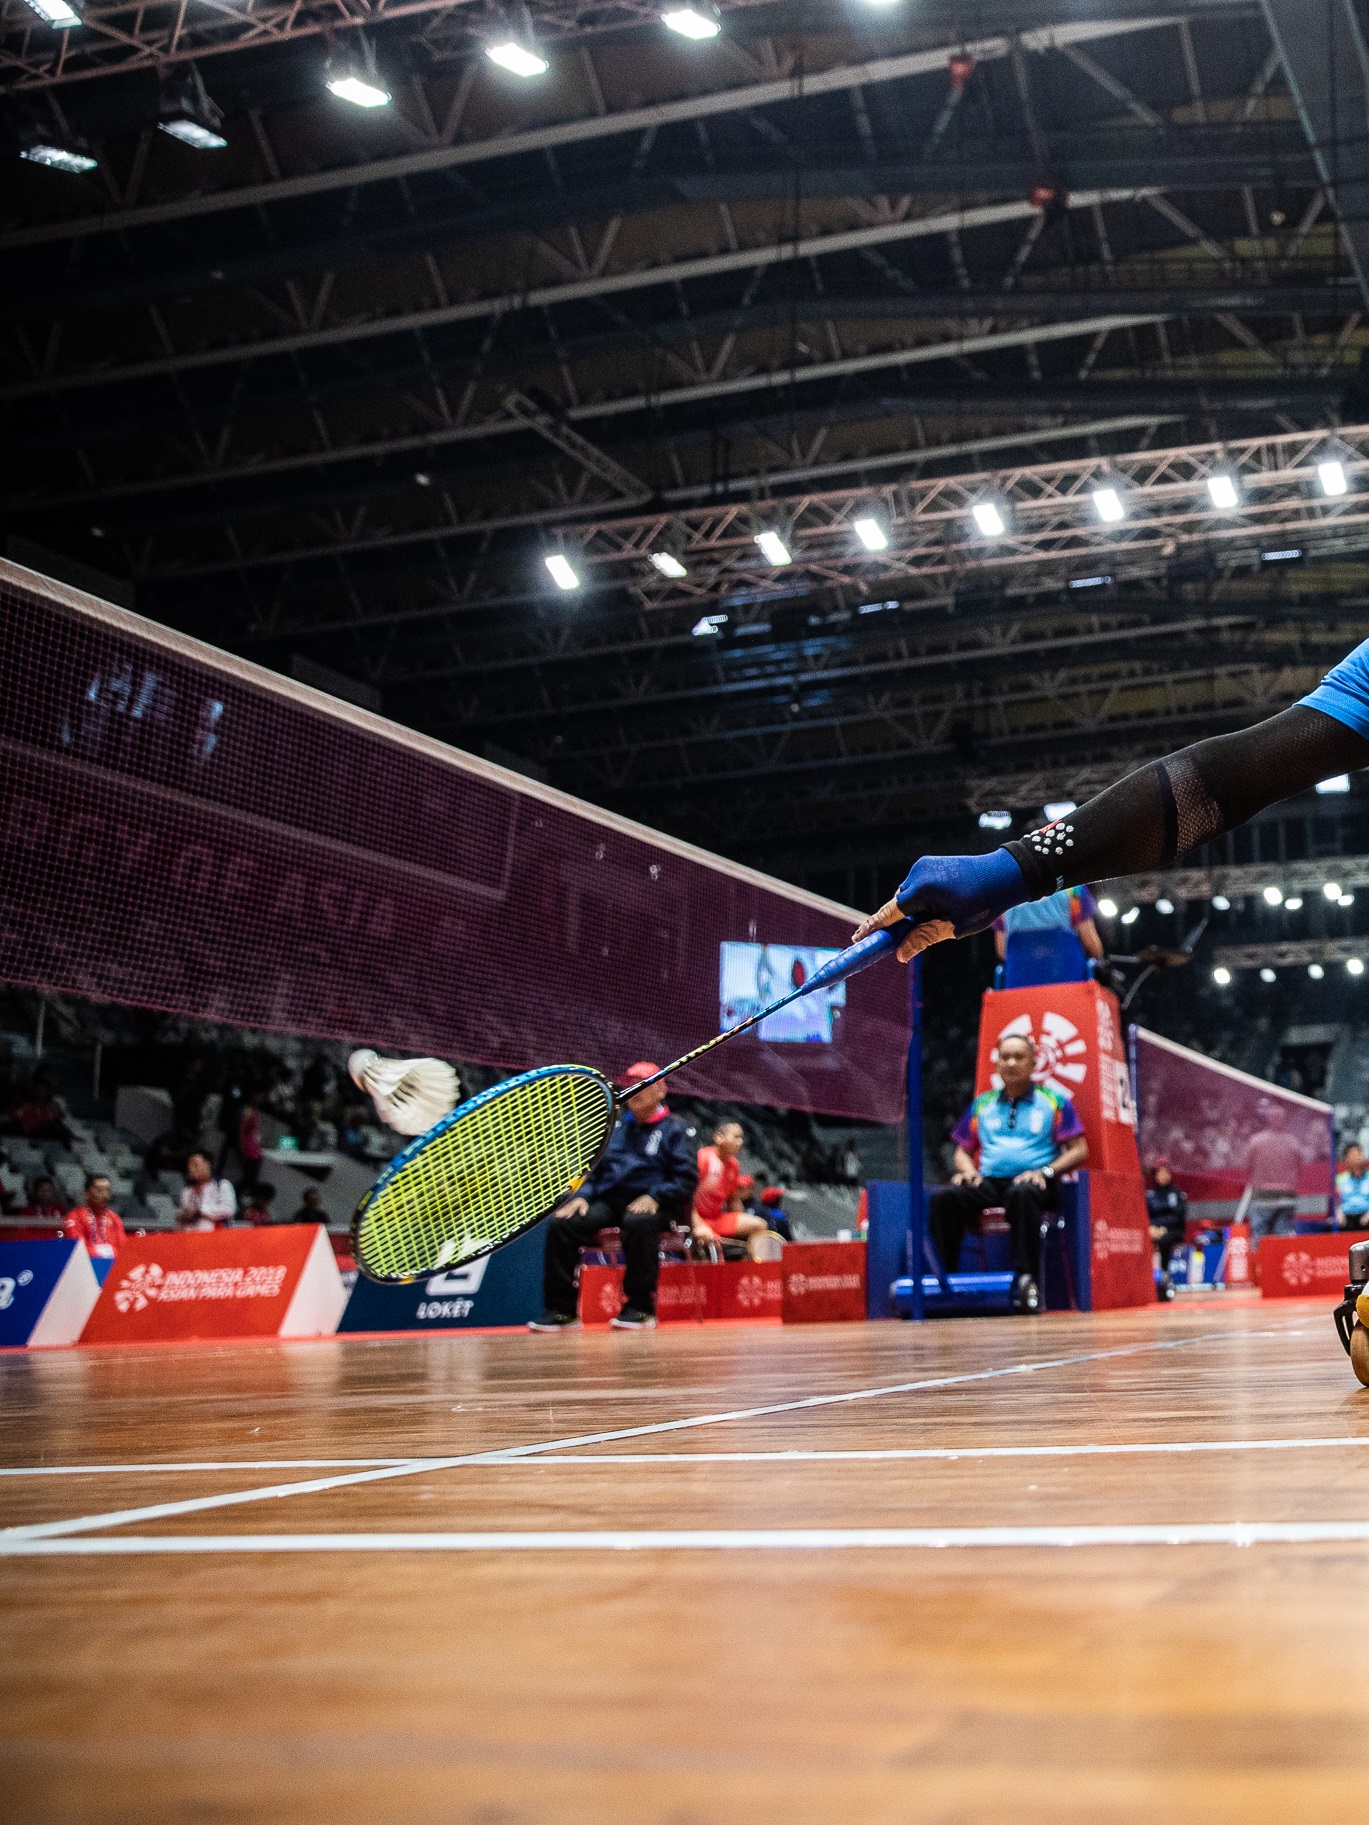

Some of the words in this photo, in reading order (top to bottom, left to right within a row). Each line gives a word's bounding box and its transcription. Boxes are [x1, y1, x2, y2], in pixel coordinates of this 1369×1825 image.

[164, 1268, 245, 1287] INDONESIA
[244, 1264, 288, 1284] 2018
[157, 1285, 198, 1302] ASIAN
[198, 1283, 236, 1300] PARA
[235, 1280, 281, 1298] GAMES
